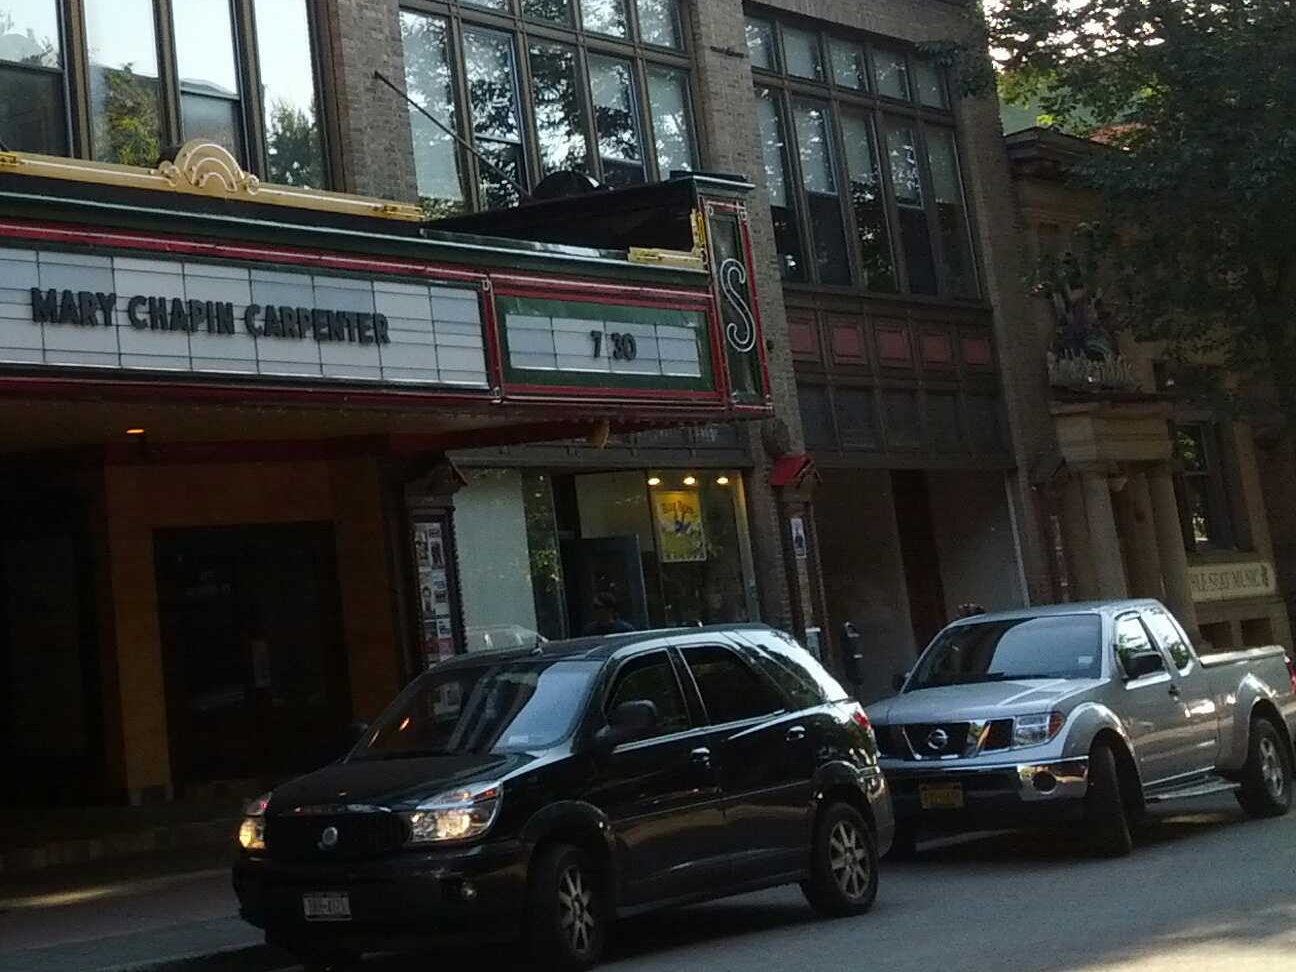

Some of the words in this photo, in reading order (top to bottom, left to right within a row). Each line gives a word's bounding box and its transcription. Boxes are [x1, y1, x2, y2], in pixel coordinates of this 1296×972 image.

[30, 286, 118, 327] MARY
[127, 294, 235, 335] CHAPIN
[244, 303, 391, 345] CARPENTER
